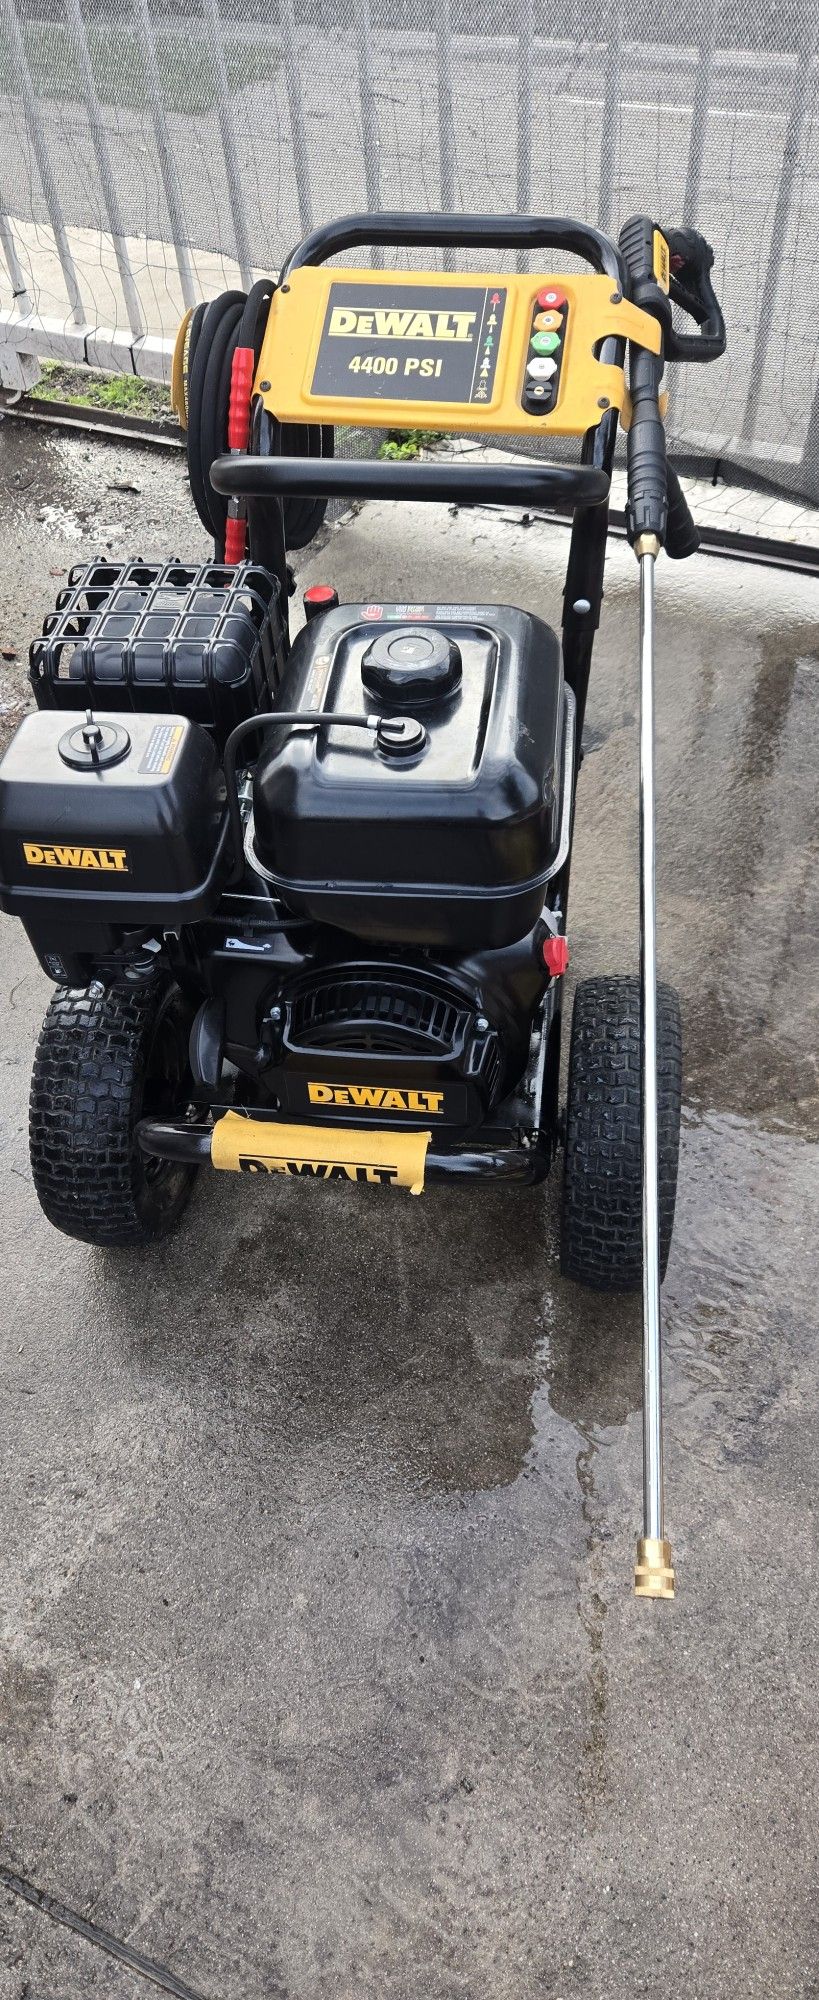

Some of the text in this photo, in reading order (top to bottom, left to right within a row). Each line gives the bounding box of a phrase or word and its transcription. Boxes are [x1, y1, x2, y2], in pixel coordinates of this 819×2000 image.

[329, 309, 476, 338] DEWALT
[349, 355, 442, 377] 4400 PSI
[23, 845, 127, 869] DEWALT
[308, 1084, 444, 1112] DEWALT
